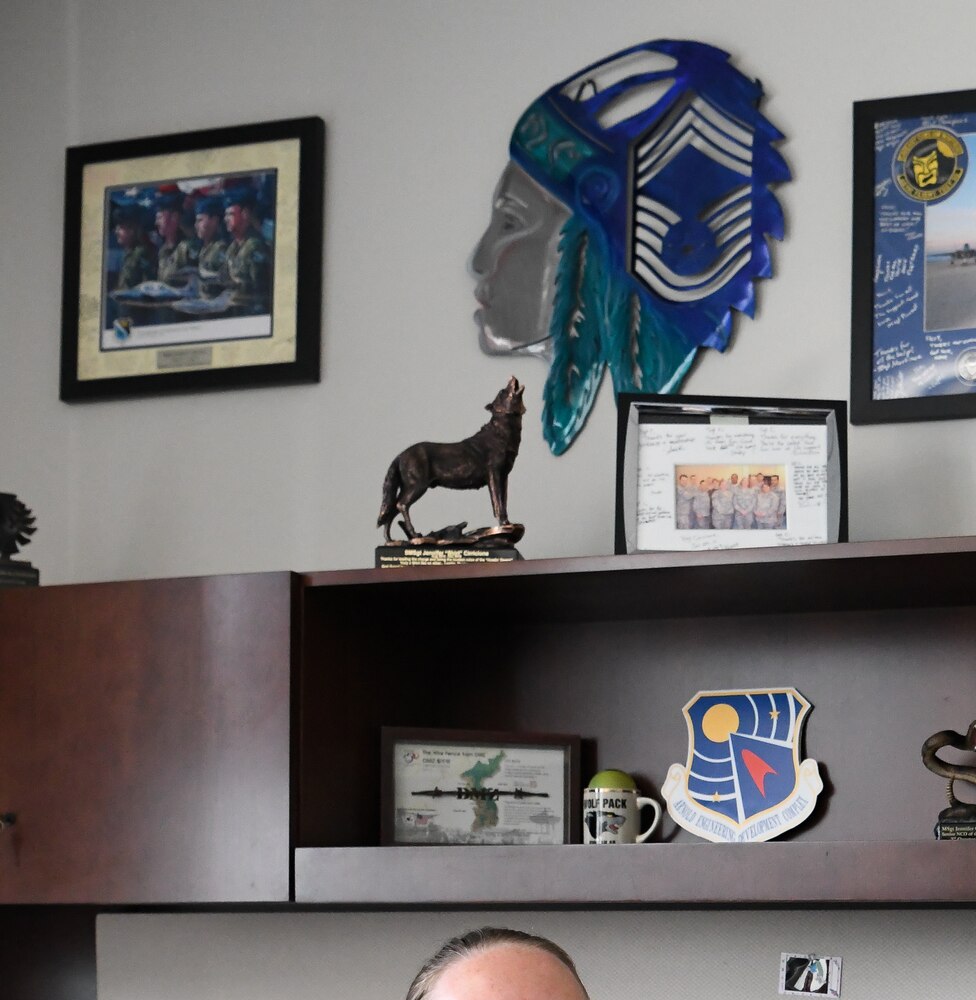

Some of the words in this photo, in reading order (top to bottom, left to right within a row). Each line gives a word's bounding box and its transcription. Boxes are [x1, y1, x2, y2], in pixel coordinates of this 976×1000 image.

[603, 799, 627, 809] PACK
[673, 799, 697, 823] ARNOLD
[781, 795, 809, 822] COMPLEX
